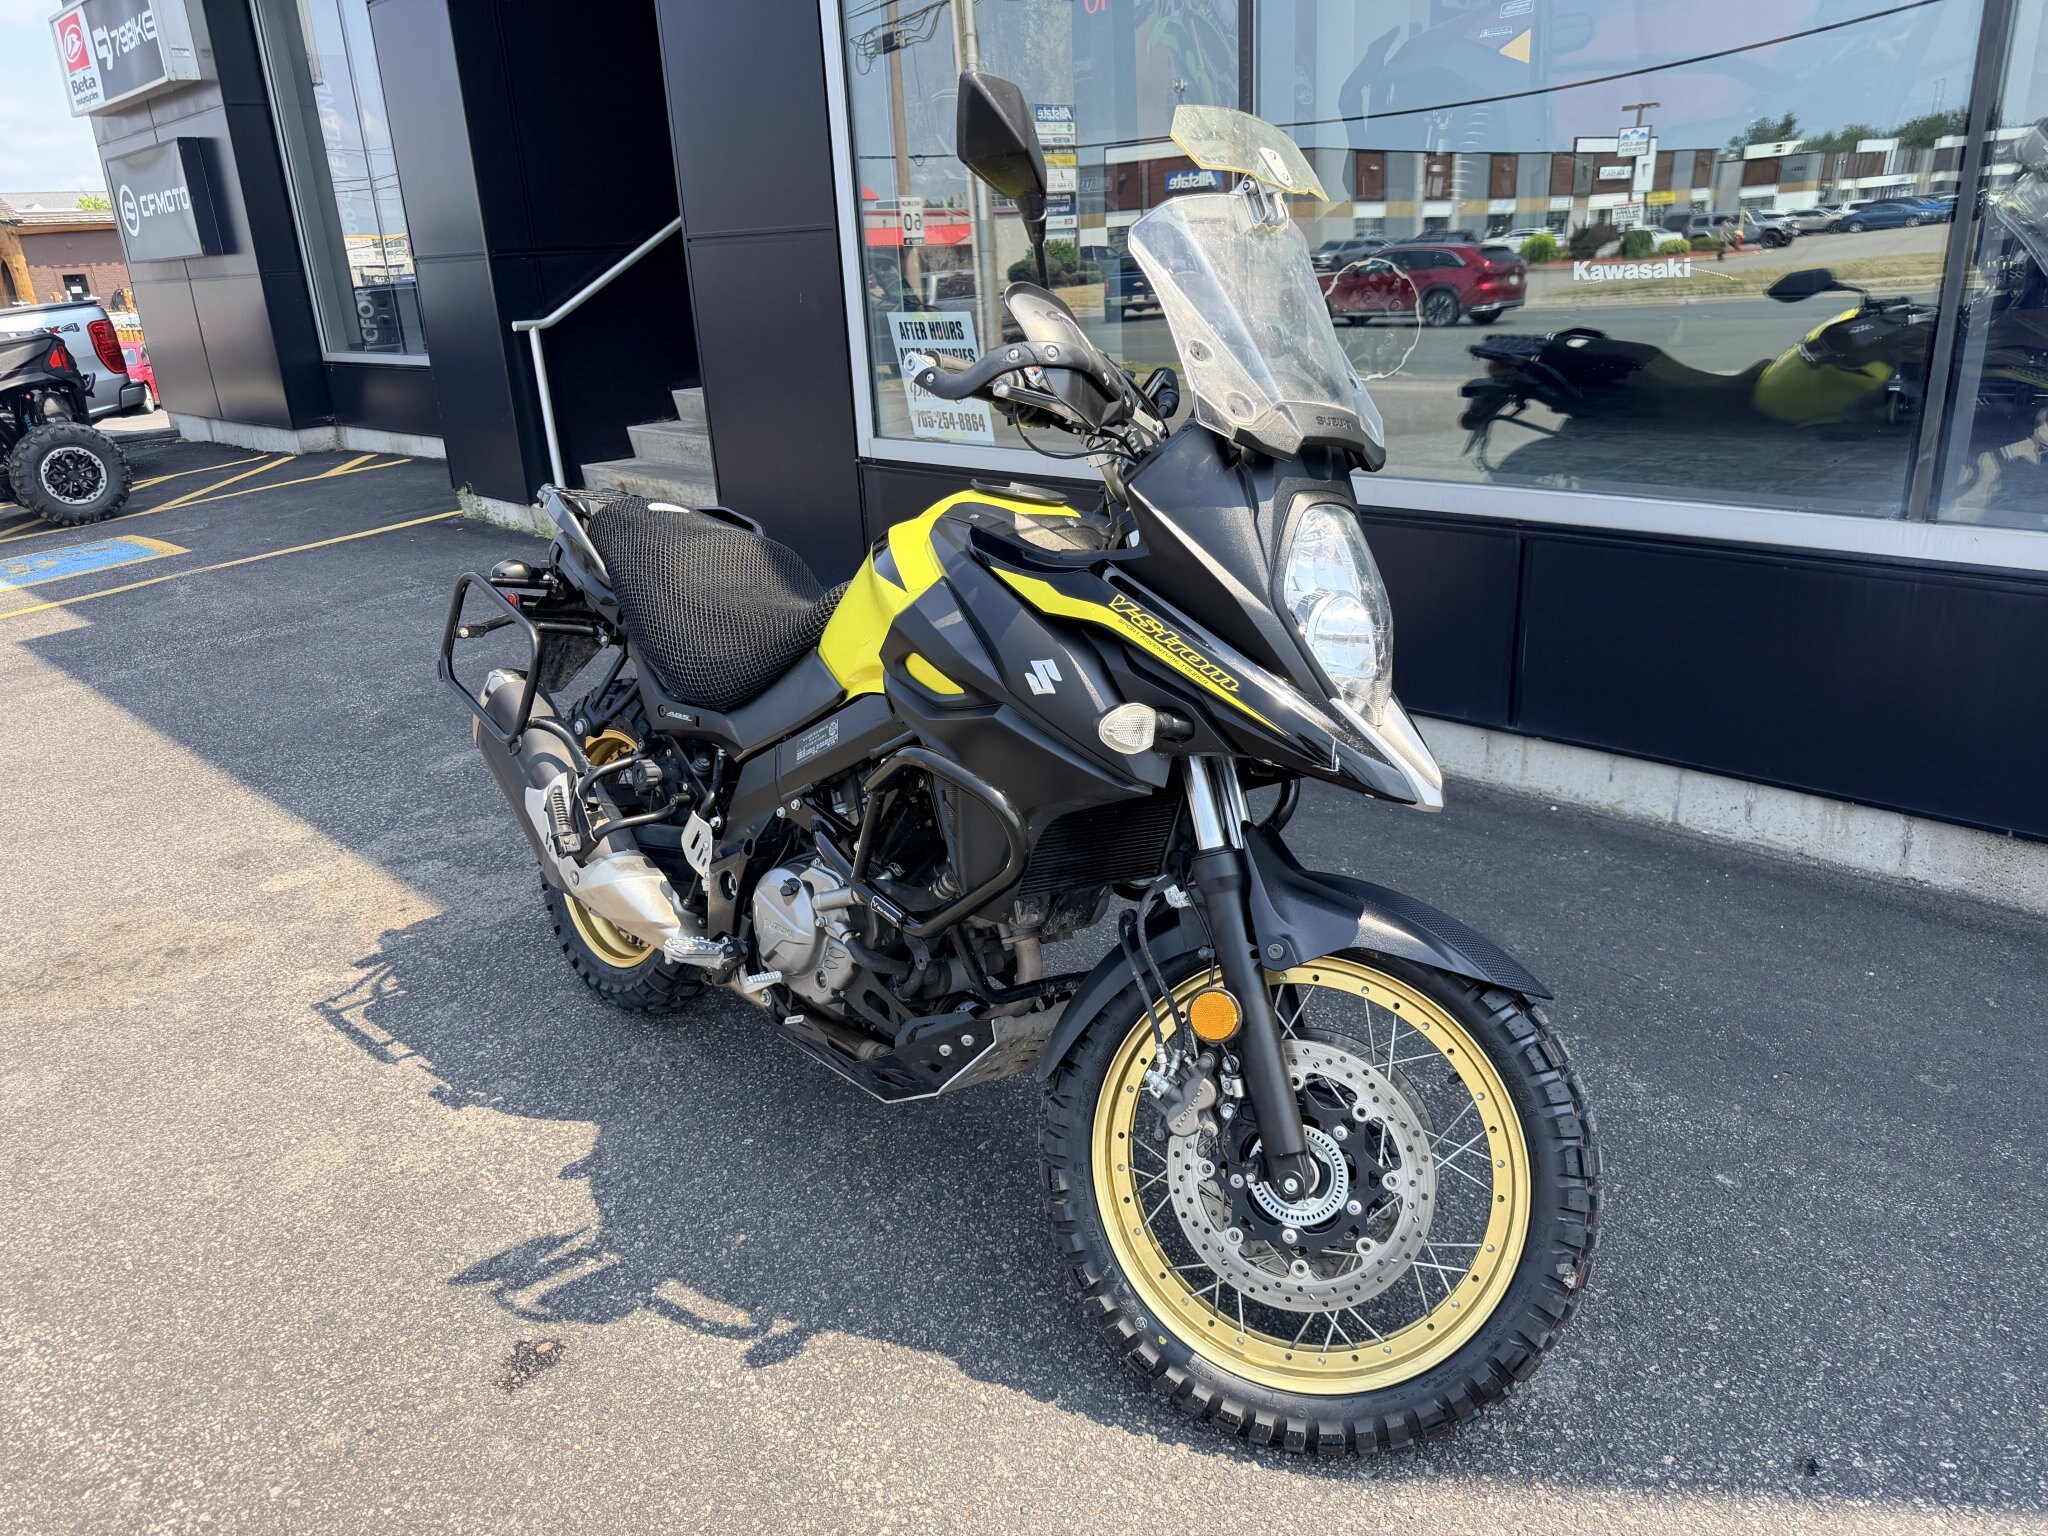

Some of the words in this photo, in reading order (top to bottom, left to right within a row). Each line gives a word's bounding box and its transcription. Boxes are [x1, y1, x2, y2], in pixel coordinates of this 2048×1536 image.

[70, 75, 97, 96] Beta
[139, 186, 190, 217] CFMOTO
[1573, 258, 1691, 281] Kawasaki
[898, 321, 927, 340] AFTER
[927, 321, 964, 340] HOURS
[914, 409, 986, 433] 705-254-8864
[1108, 593, 1240, 692] V-Strom
[1117, 618, 1141, 636] SPORT
[1140, 634, 1181, 665] ADVENTURE
[1180, 663, 1210, 686] TOURER
[762, 918, 794, 939] SUZUKI
[1174, 1086, 1204, 1128] TOKICO
